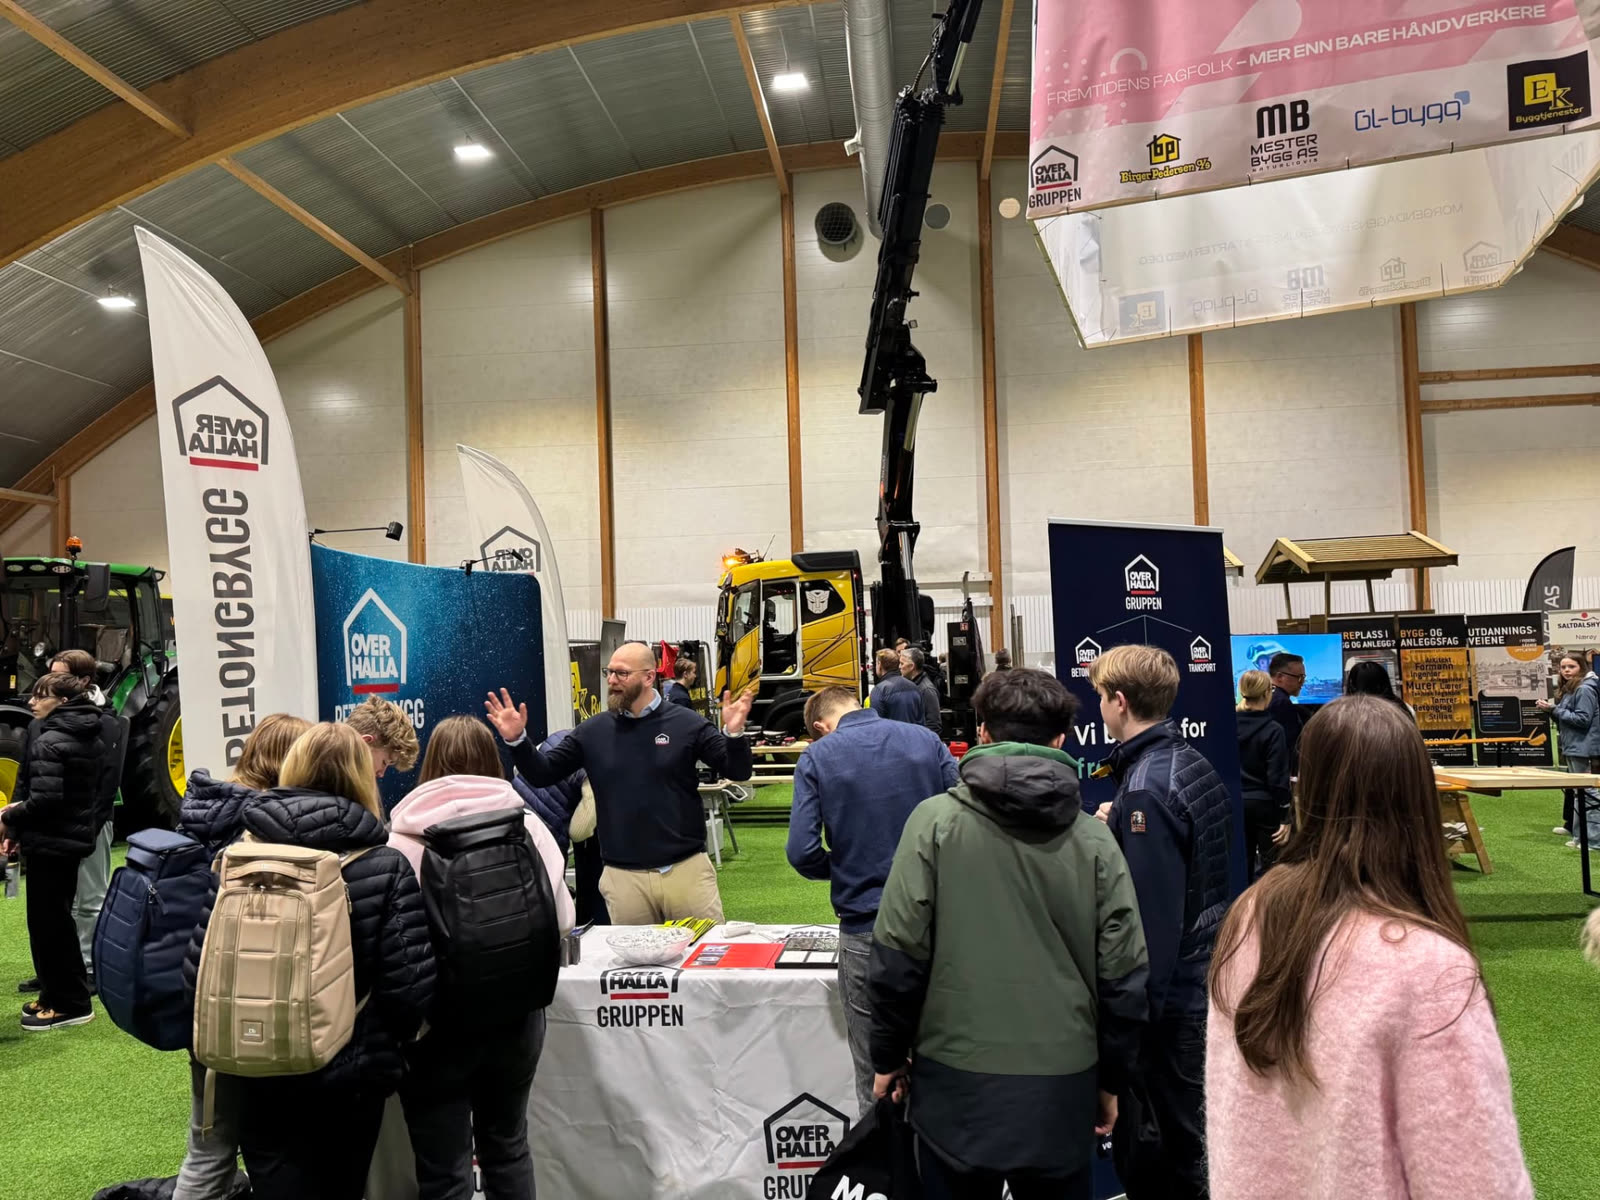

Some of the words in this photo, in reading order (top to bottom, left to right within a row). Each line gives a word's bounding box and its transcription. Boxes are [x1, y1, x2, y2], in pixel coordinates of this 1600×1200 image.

[1047, 76, 1150, 105] FREMTIDENS
[1153, 60, 1232, 89] FAGFOLK
[1250, 48, 1291, 67] MER
[1294, 38, 1334, 58] ENN
[1336, 28, 1390, 51] BARE
[1393, 5, 1547, 41] HÅNDVERKERE
[1256, 99, 1310, 139] MB
[1515, 106, 1585, 124] Byggtjenester
[1250, 133, 1318, 156] MESTER
[1251, 150, 1293, 167] BYGG
[1297, 146, 1319, 160] AS
[1035, 162, 1067, 176] OVER
[1035, 171, 1072, 185] HALLA
[1120, 169, 1152, 183] Birger
[1151, 163, 1196, 181] Pedersen
[1029, 187, 1082, 208] GRUPPEN
[1130, 571, 1152, 581] OVER
[1130, 580, 1156, 590] HALLA
[1125, 597, 1162, 610] GRUPPEN
[1543, 585, 1560, 608] AS
[1400, 628, 1428, 638] BYGG-
[1429, 628, 1443, 637] OG
[1467, 625, 1537, 637] UTDANNINGS-
[352, 633, 390, 656] OVER
[1351, 640, 1361, 649] OG
[1363, 639, 1396, 648] ANLEGG?
[1400, 636, 1459, 647] ANLEGGSFAG
[1467, 635, 1506, 646] VEIENE
[351, 654, 399, 680] HALLA
[1188, 663, 1217, 672] TRANSPORT
[1406, 681, 1436, 691] Murer
[1073, 721, 1097, 746] Vi
[1181, 717, 1207, 739] for
[609, 975, 669, 991] HALLA
[596, 1003, 684, 1028] GRUPPEN
[775, 1124, 830, 1143] OVER
[776, 1140, 837, 1160] HALLA
